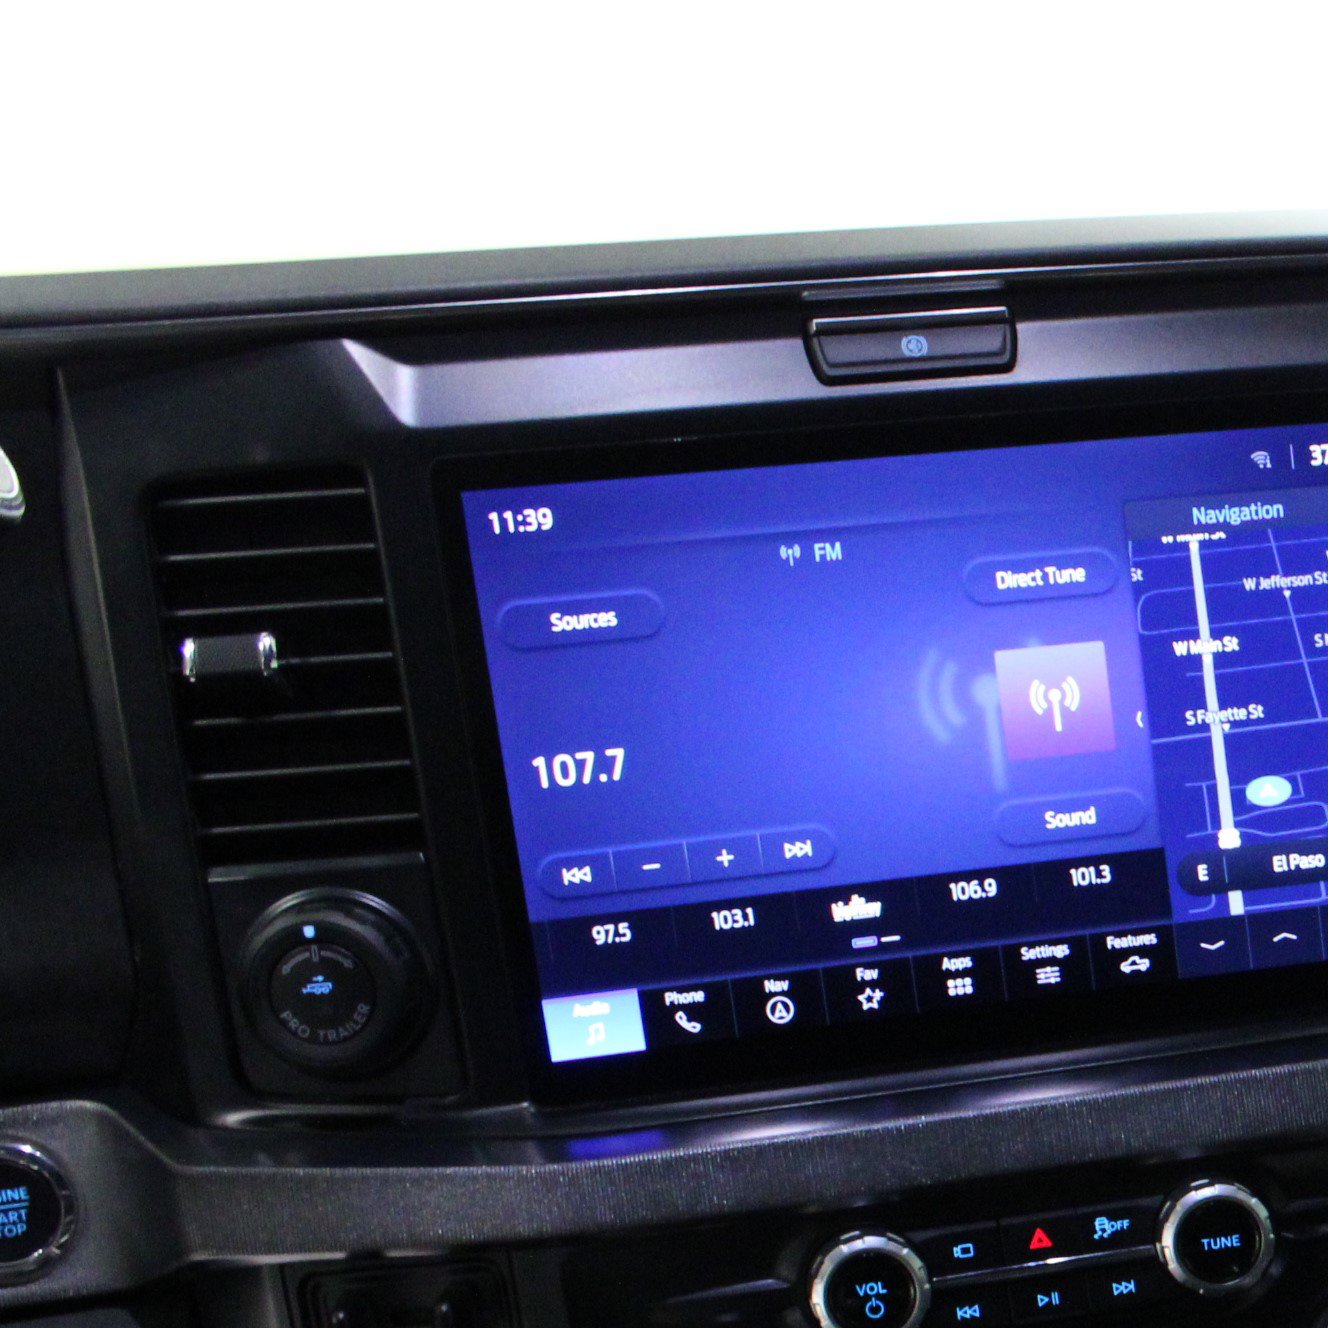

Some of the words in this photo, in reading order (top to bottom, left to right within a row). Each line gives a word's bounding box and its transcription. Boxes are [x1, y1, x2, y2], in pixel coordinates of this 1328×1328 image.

[488, 507, 553, 534] 11:39
[1192, 502, 1284, 526] Navigation
[814, 541, 842, 562] FM
[995, 567, 1042, 590] Direct
[1045, 565, 1086, 585] Tune
[1243, 577, 1256, 591] W
[1258, 573, 1314, 590] Jefferson
[1314, 570, 1328, 585] St
[550, 610, 618, 632] Sources
[1172, 641, 1188, 656] W
[1222, 635, 1240, 652] St
[1314, 634, 1323, 647] S
[1185, 711, 1194, 726] S
[1196, 706, 1248, 726] Fayette
[1249, 704, 1264, 720] St
[532, 748, 625, 789] 107.7
[1044, 807, 1096, 829] Sound
[1273, 855, 1288, 872] El
[1290, 853, 1325, 871] Paso
[1070, 864, 1112, 887] 101.3
[1197, 865, 1209, 882] E
[950, 878, 997, 901] 106.9
[711, 907, 755, 930] 103.1
[591, 922, 631, 945] 97.5
[1107, 932, 1157, 950] Features
[1021, 943, 1070, 961] Settings
[942, 956, 972, 972] Apps
[855, 968, 878, 982] Fav
[764, 979, 789, 994] Nav
[664, 990, 705, 1006] Phone
[280, 1010, 310, 1038] PRO
[318, 1003, 371, 1042] TRAILER
[0, 1187, 29, 1202] INE
[0, 1209, 27, 1223] ART
[1108, 1217, 1130, 1233] OFF
[1201, 1234, 1240, 1250] TUNE
[855, 1280, 887, 1297] VOL
